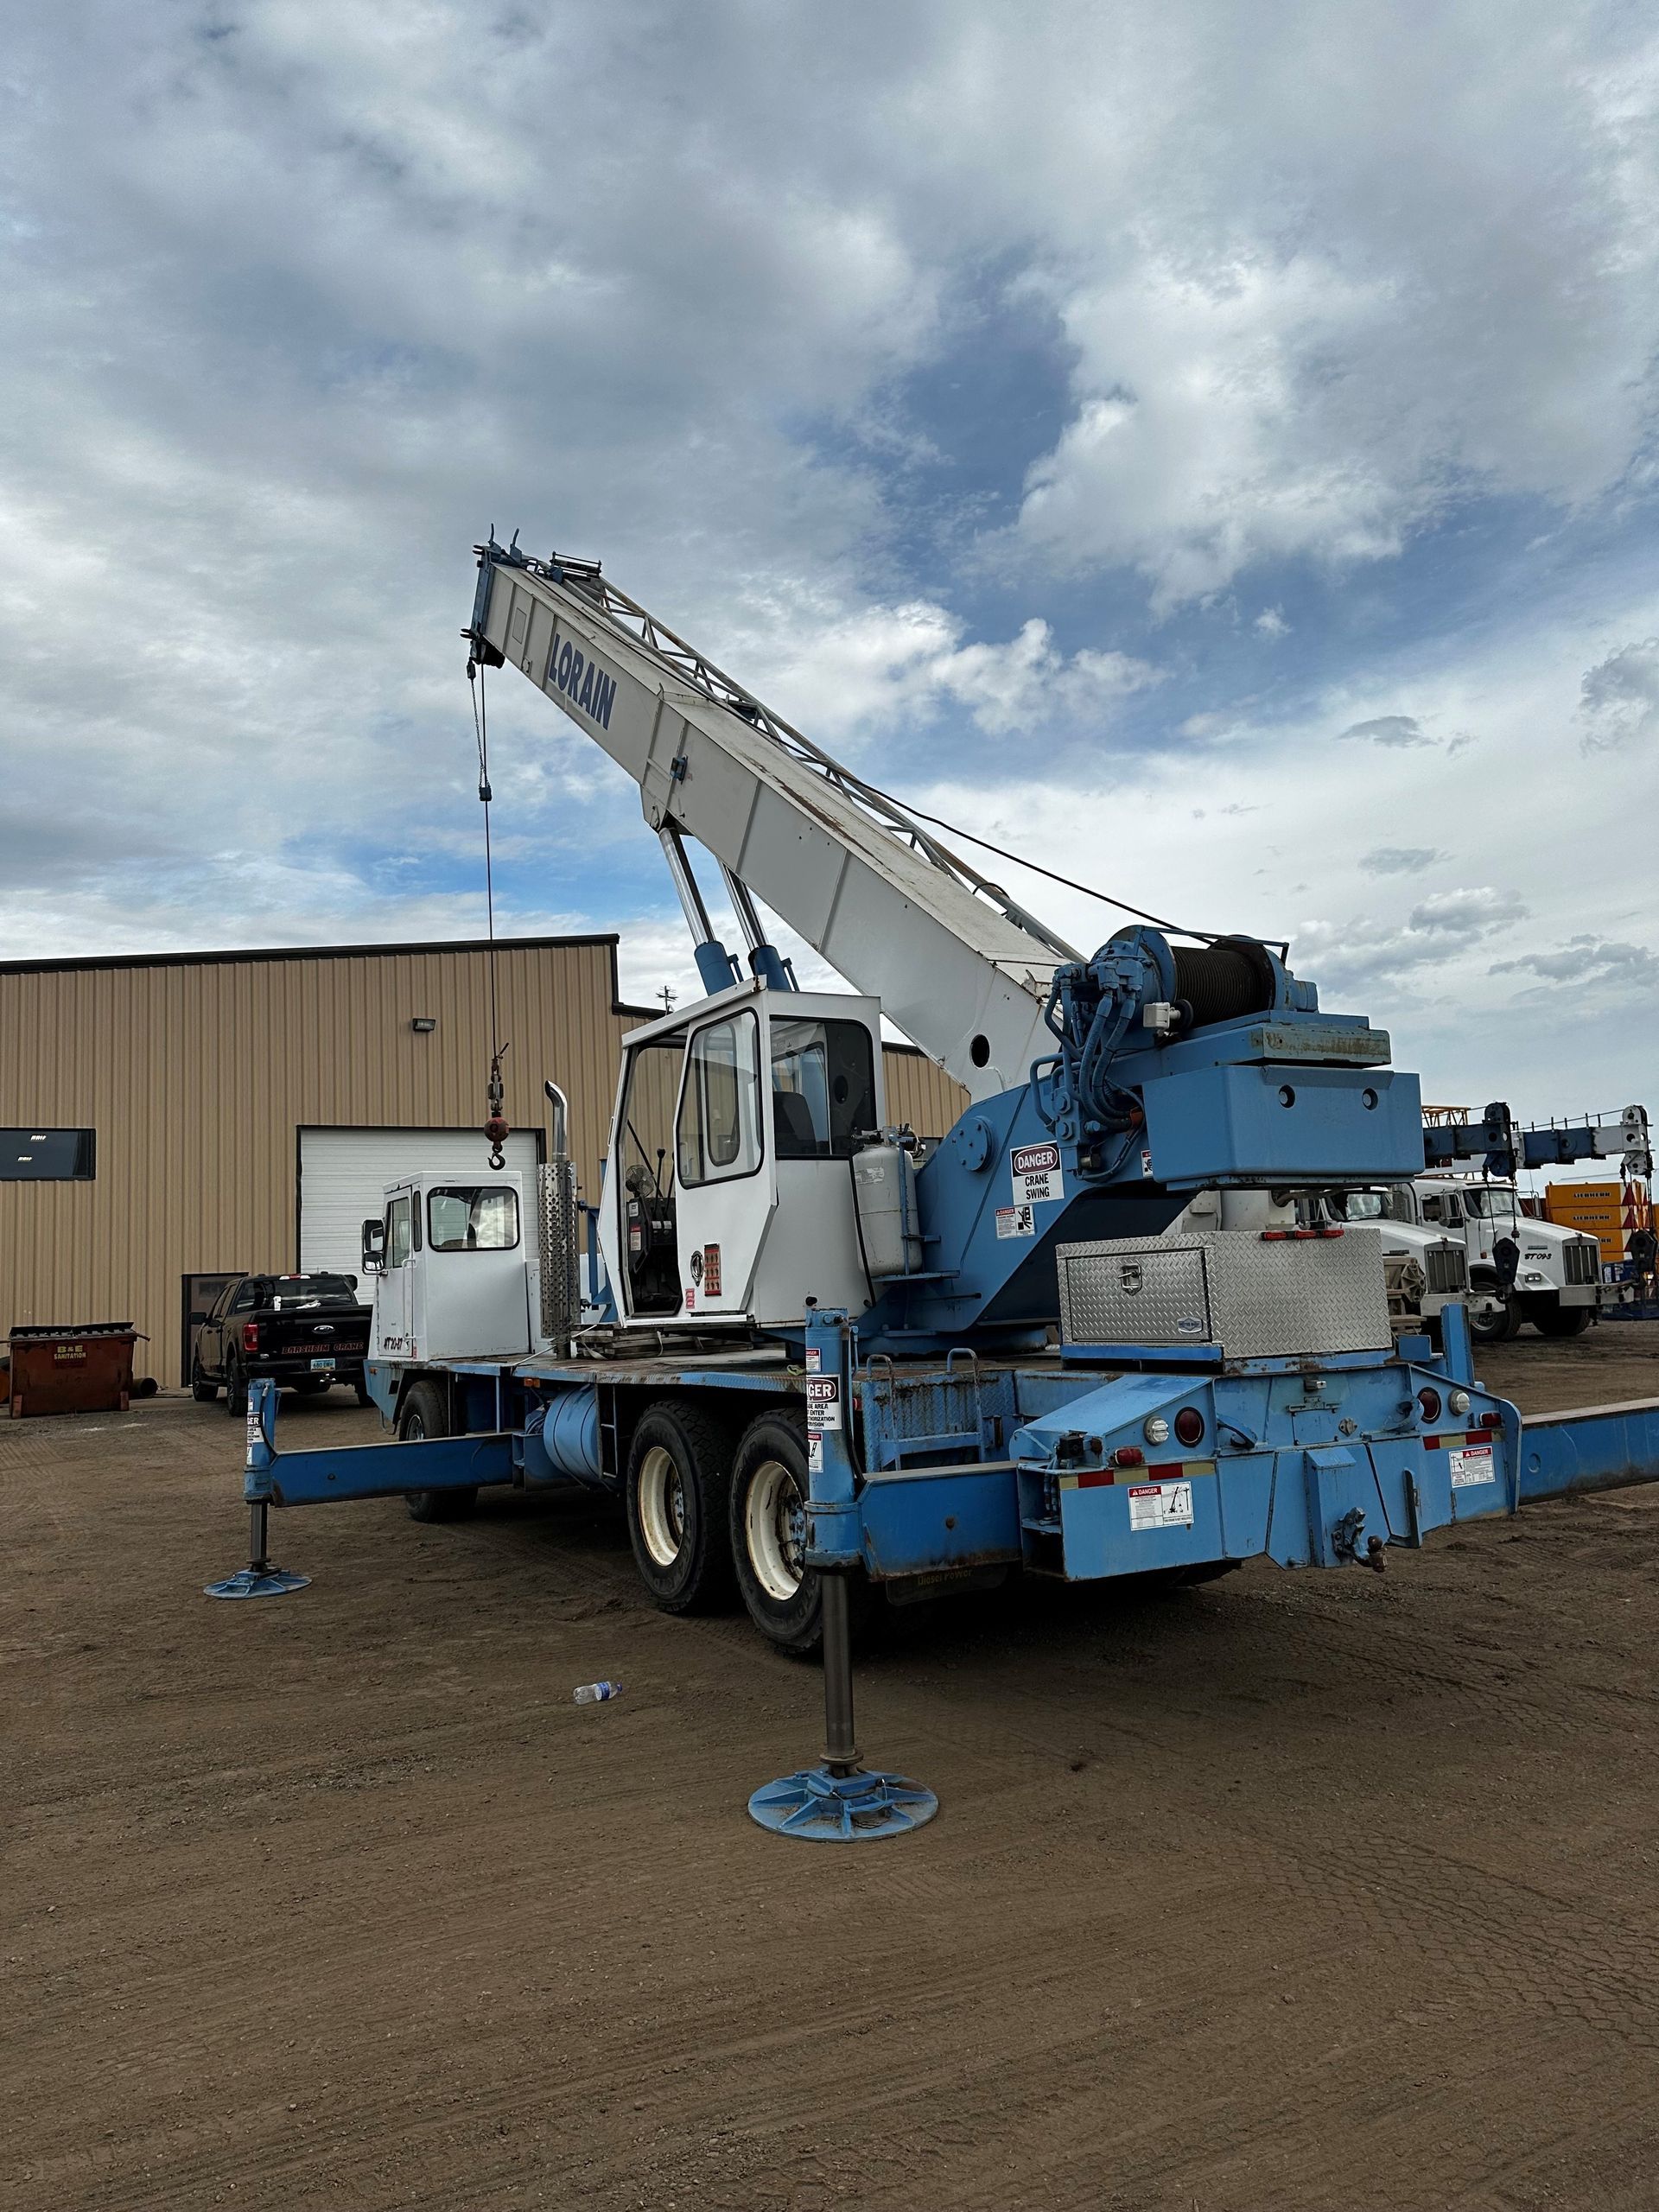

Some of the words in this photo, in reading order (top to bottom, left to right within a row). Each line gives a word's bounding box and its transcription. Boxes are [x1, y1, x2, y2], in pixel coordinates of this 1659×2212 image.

[549, 632, 617, 731] LORAIN
[1018, 1151, 1053, 1169] DANGER
[1025, 1173, 1049, 1186] CRANE
[1026, 1186, 1050, 1200] SWING
